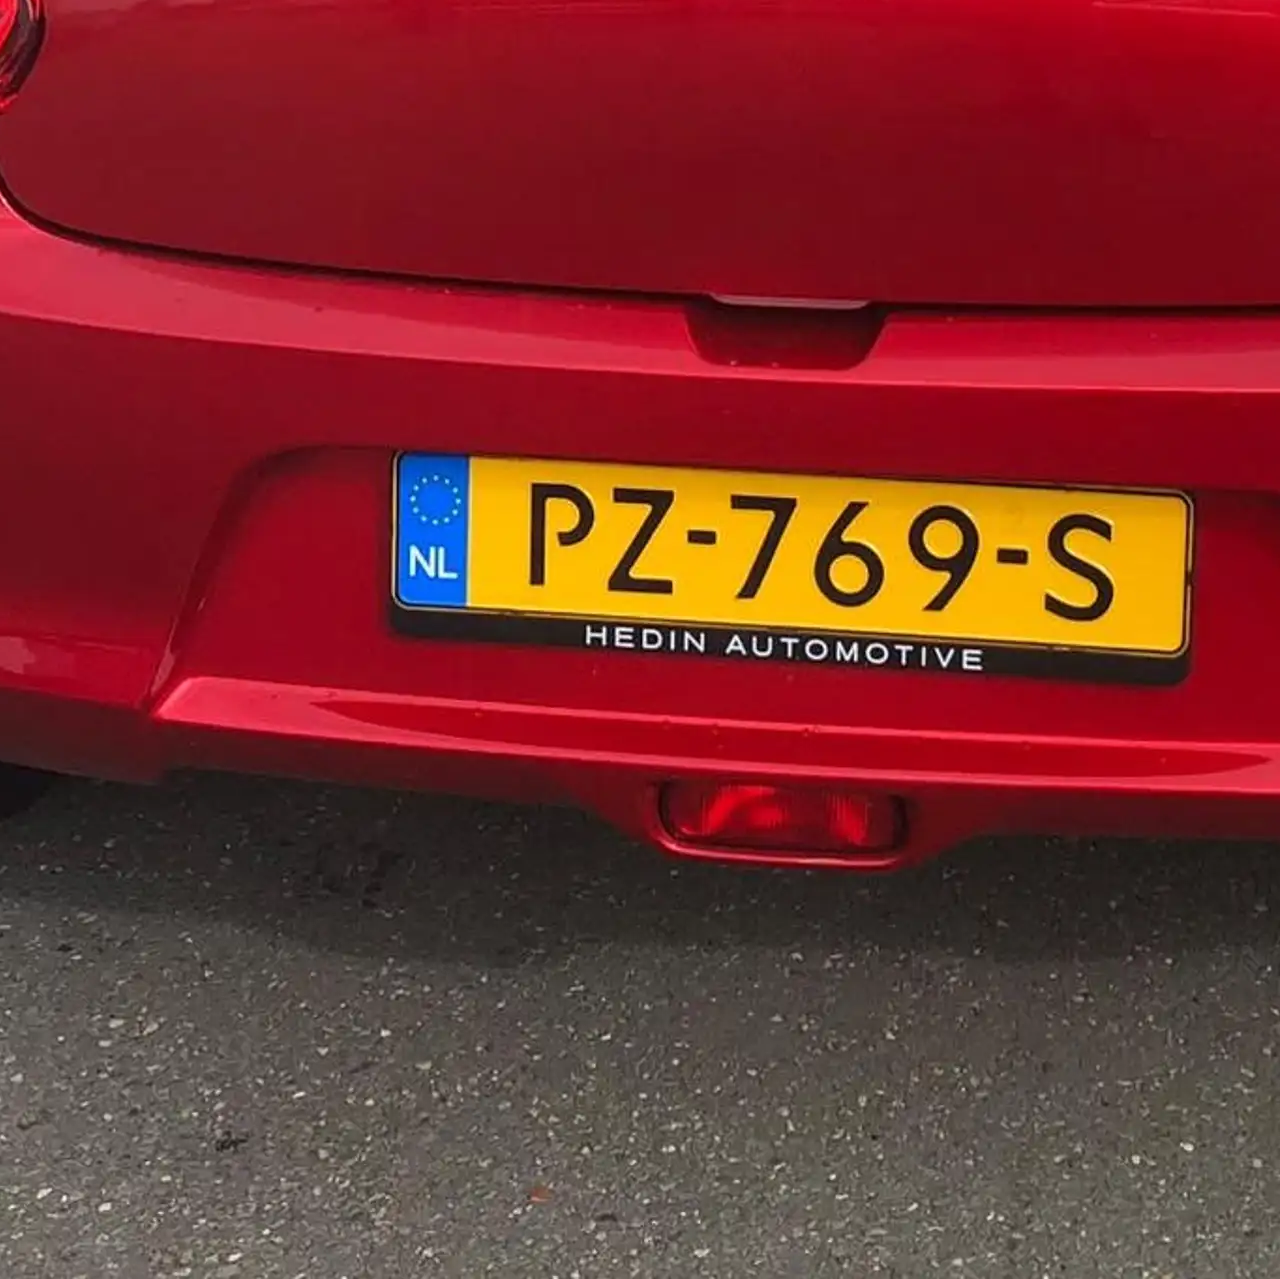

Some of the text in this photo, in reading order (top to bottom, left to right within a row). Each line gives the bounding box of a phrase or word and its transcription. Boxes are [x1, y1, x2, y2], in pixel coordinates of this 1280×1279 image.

[408, 544, 458, 580] NL
[529, 482, 1115, 622] PZ-769-S
[585, 624, 984, 671] HEDIN AUTOMOTIVE
